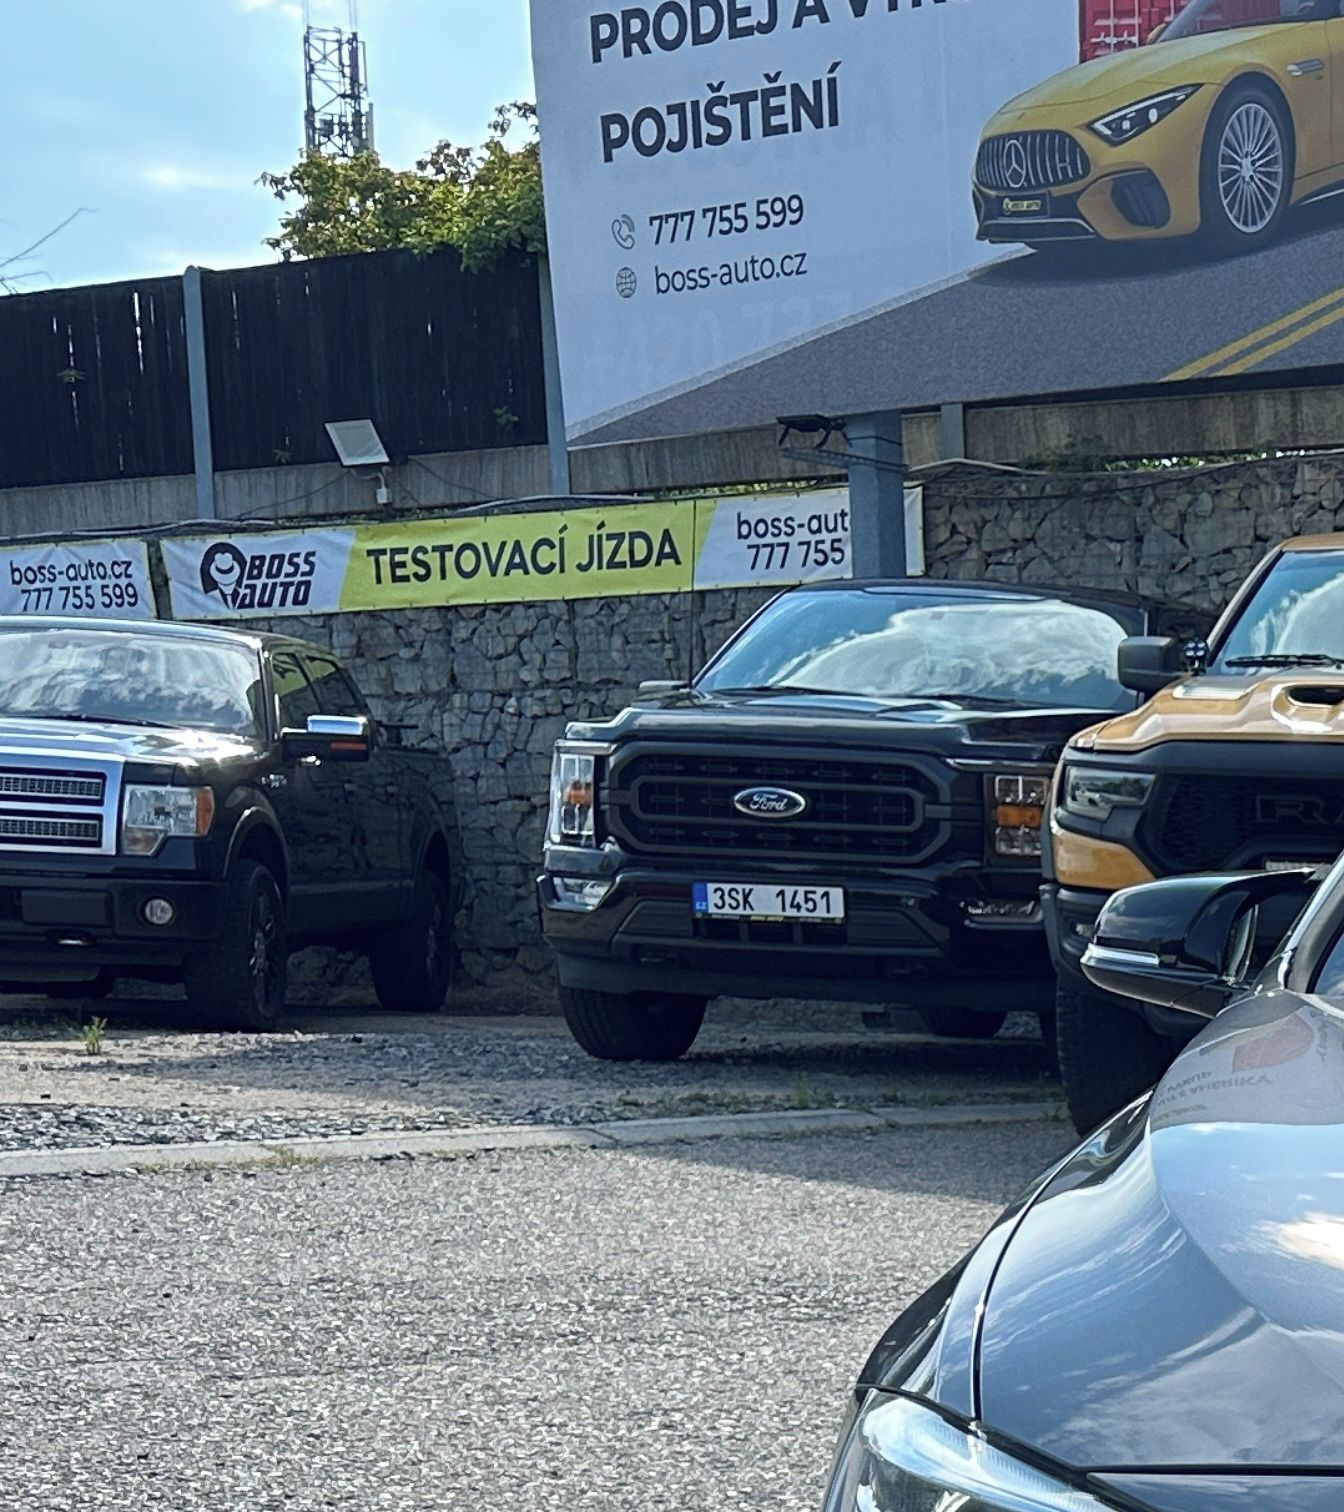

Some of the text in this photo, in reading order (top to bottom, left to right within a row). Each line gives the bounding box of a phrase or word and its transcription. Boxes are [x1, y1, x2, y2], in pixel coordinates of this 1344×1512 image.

[589, 0, 778, 63] PRODEJ
[600, 61, 842, 163] POJIŠTĚNÍ
[649, 194, 804, 245] 777 755 599
[654, 252, 807, 294] boss-auto.cz
[737, 509, 848, 539] boss-aut
[246, 551, 317, 580] BOSS
[366, 520, 682, 584] TESTOVACÍ JÍZDA
[747, 538, 845, 571] 777 755
[10, 560, 132, 585] boss-auto.cz
[21, 582, 138, 612] 777 755 599
[237, 580, 311, 609] AUTO
[750, 793, 788, 810] Ford
[713, 887, 831, 914] 3SK 1451
